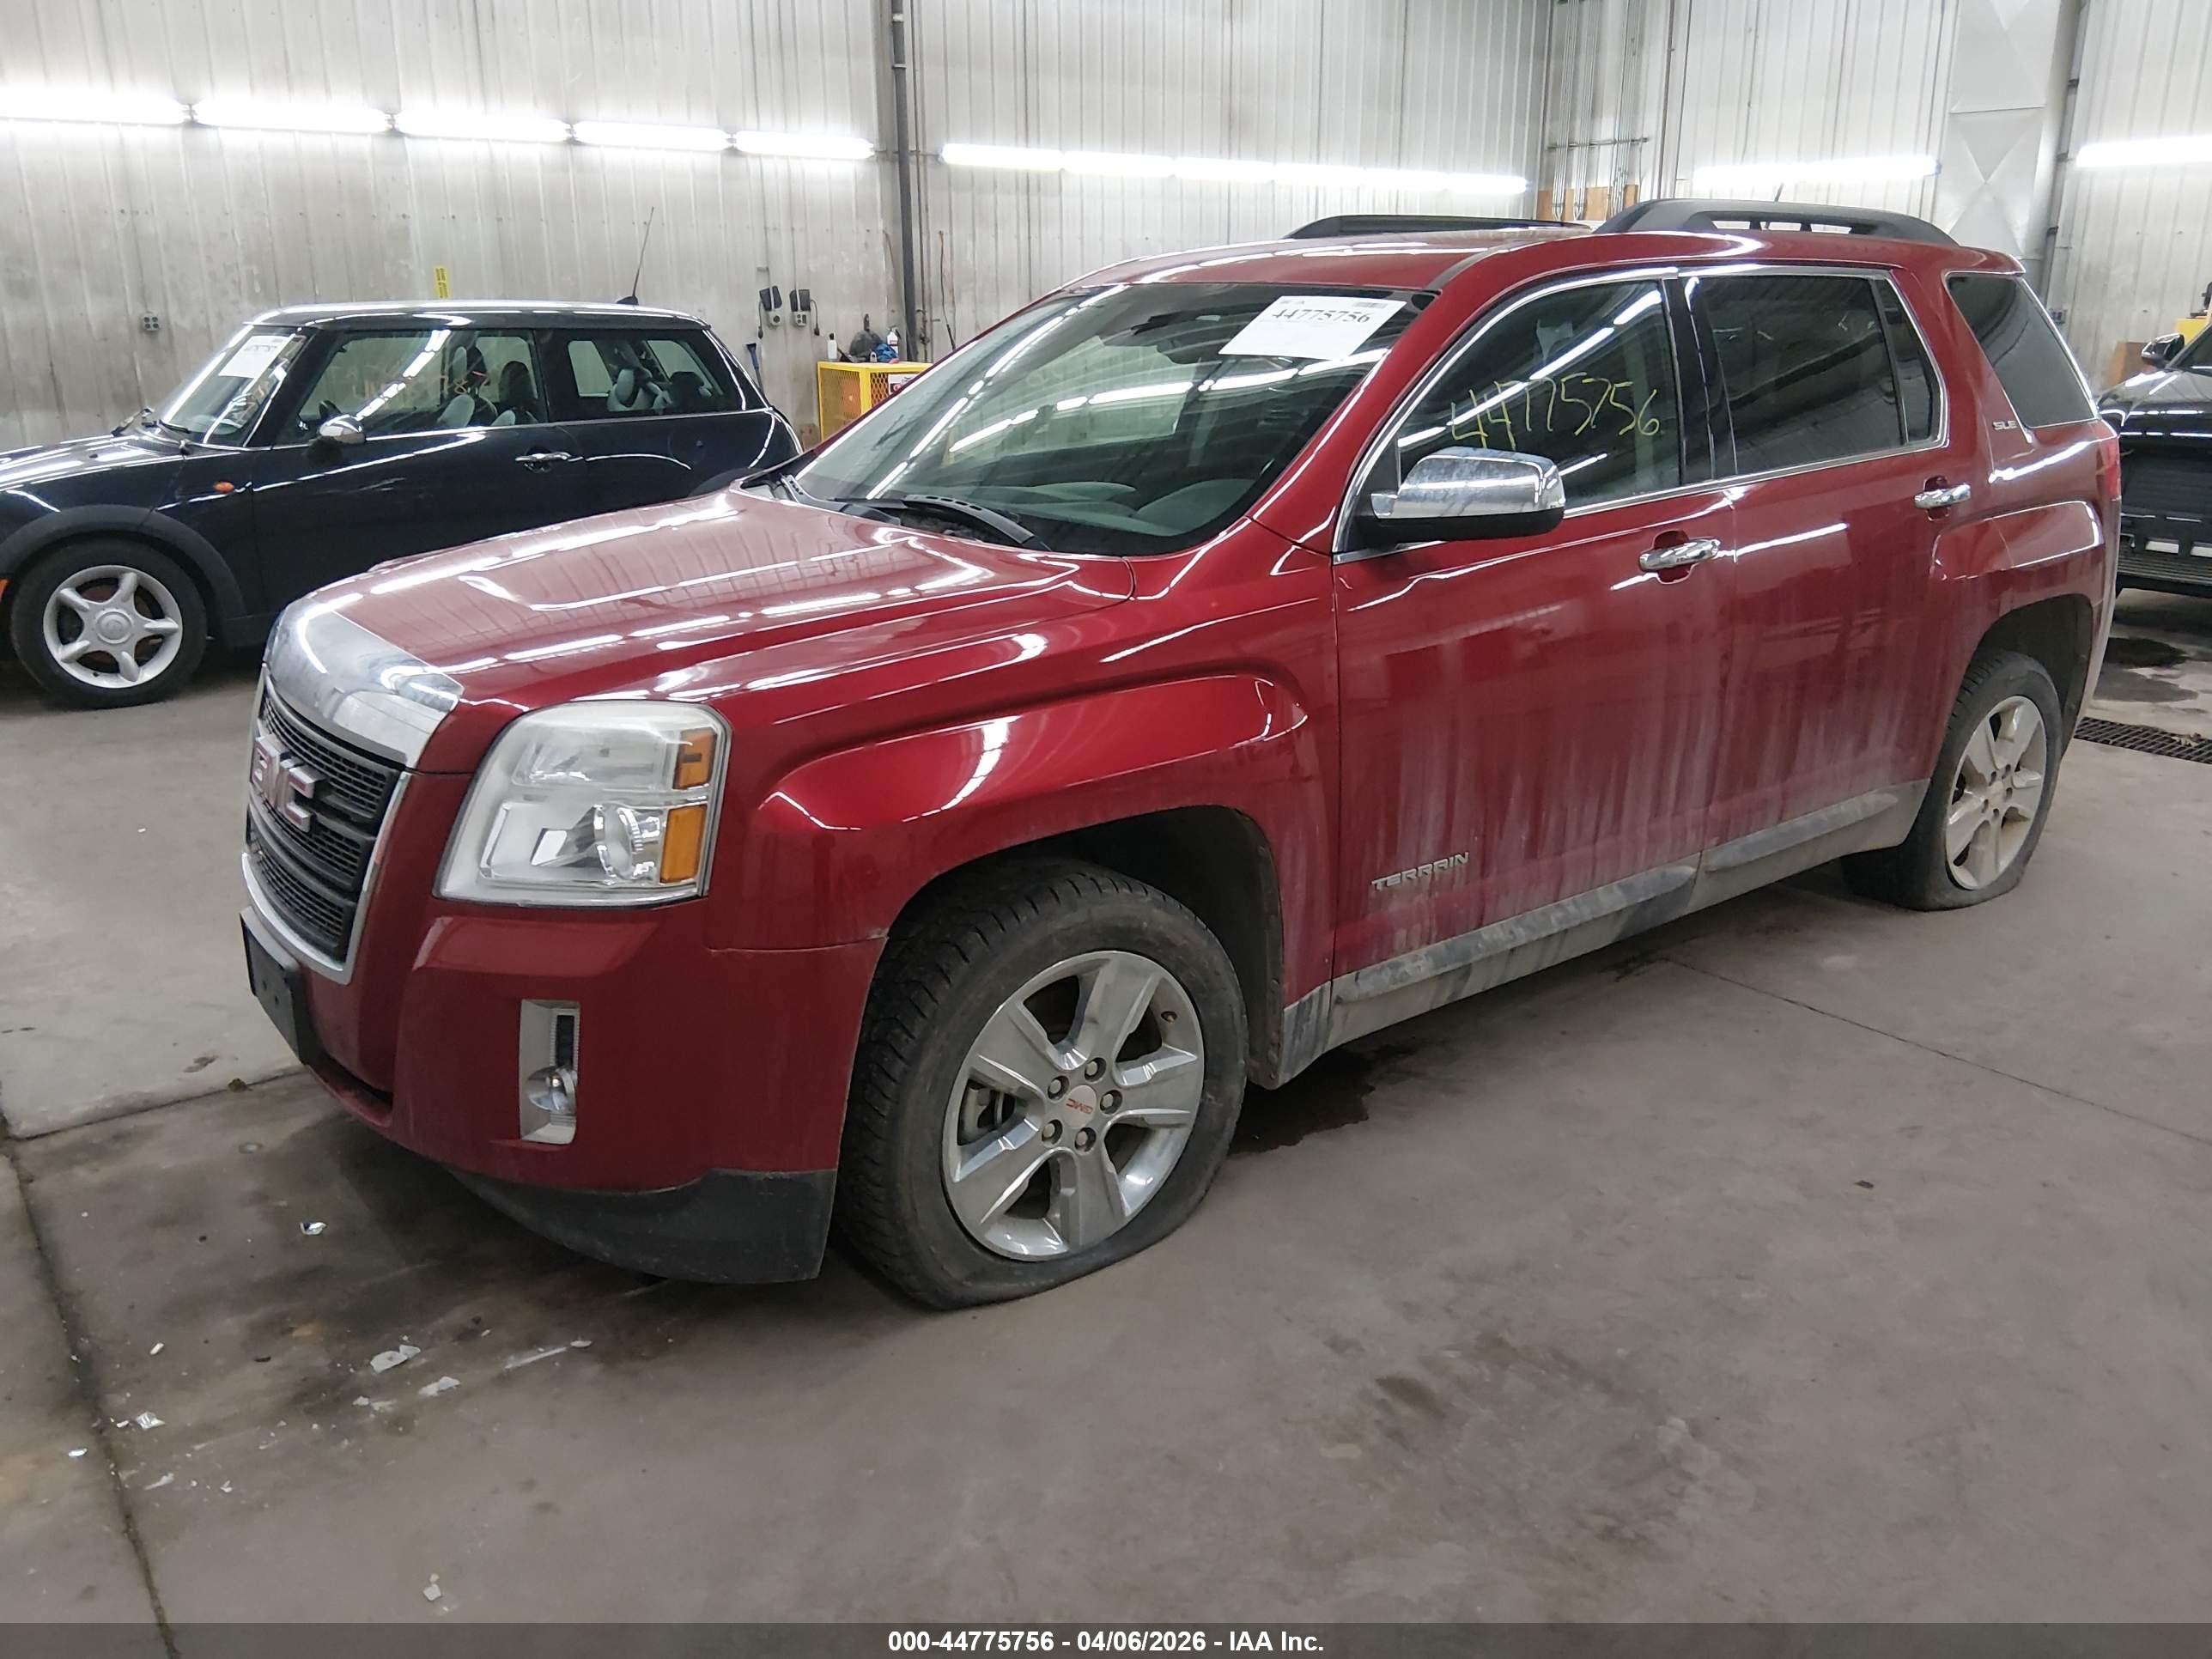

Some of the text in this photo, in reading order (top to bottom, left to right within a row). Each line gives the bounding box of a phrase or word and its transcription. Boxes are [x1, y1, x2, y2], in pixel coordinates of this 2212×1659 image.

[1273, 308, 1374, 324] 44775756
[1370, 851, 1470, 892] TERRAIN
[1066, 1097, 1094, 1115] GMC
